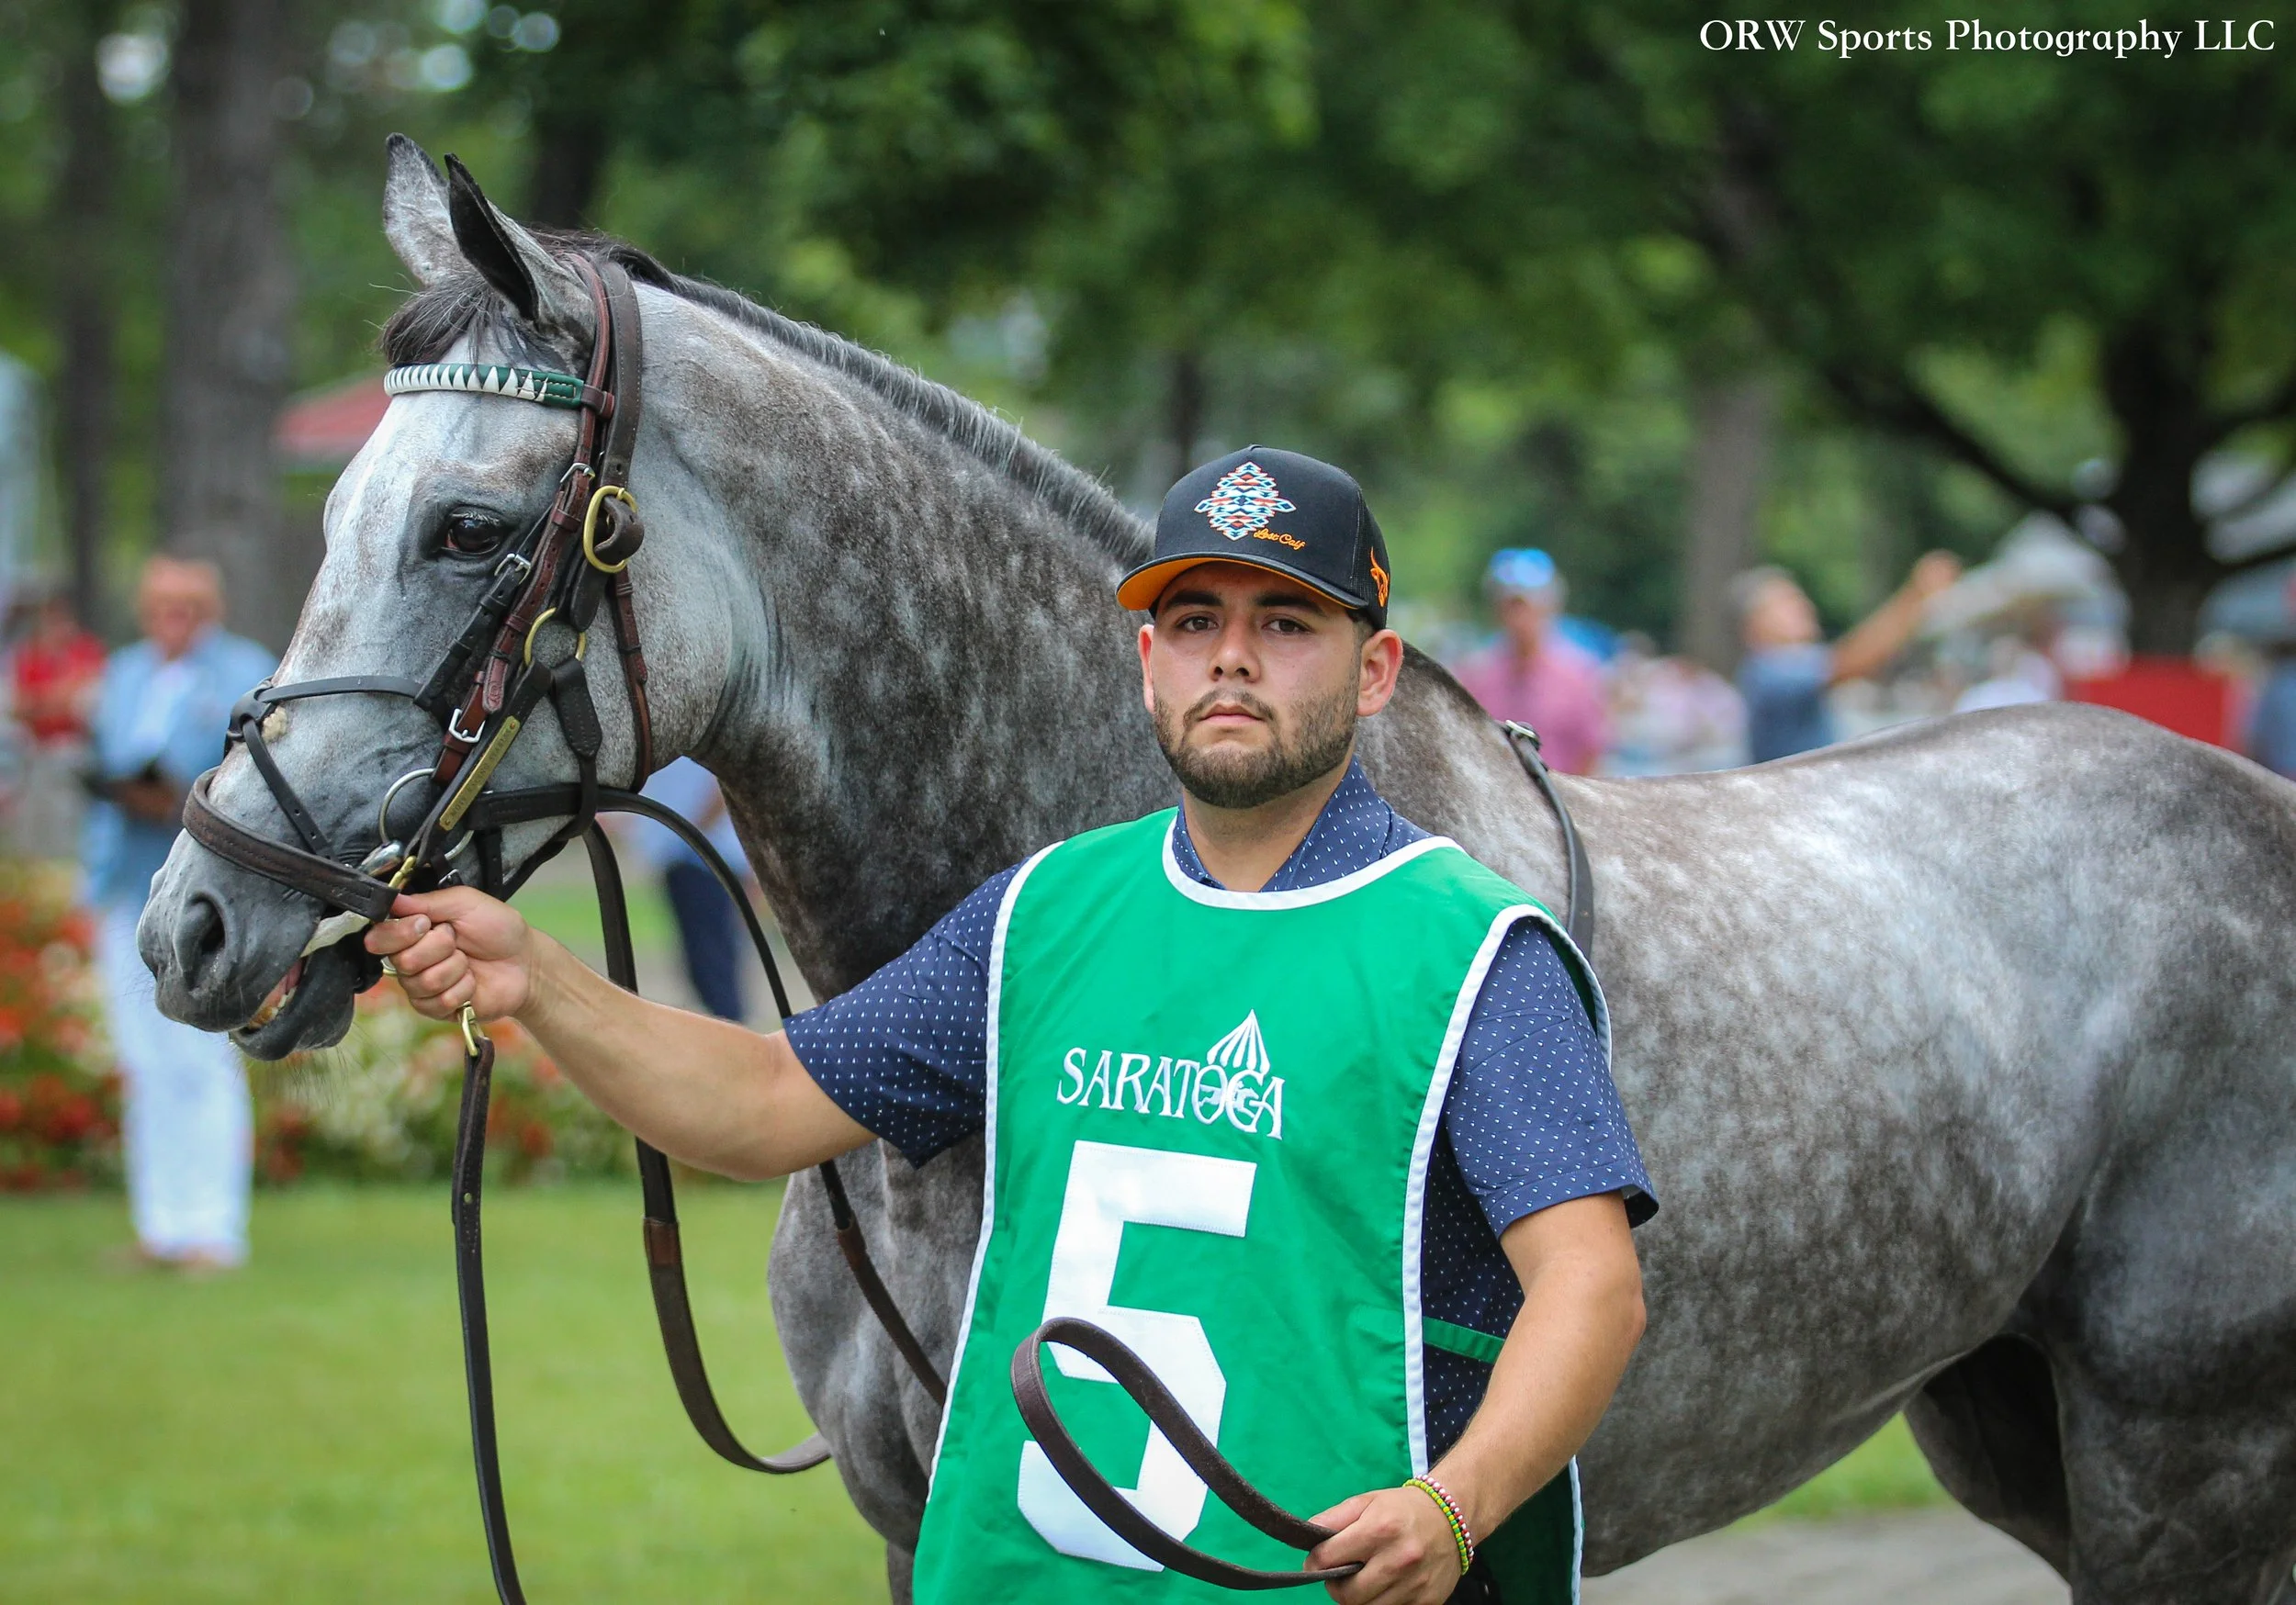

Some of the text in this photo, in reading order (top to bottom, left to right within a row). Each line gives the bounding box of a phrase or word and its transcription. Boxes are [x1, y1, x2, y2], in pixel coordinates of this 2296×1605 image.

[1253, 528, 1306, 551] Lost Calf
[1056, 1046, 1286, 1141] SARATOGA
[1017, 1139, 1258, 1573] 5
